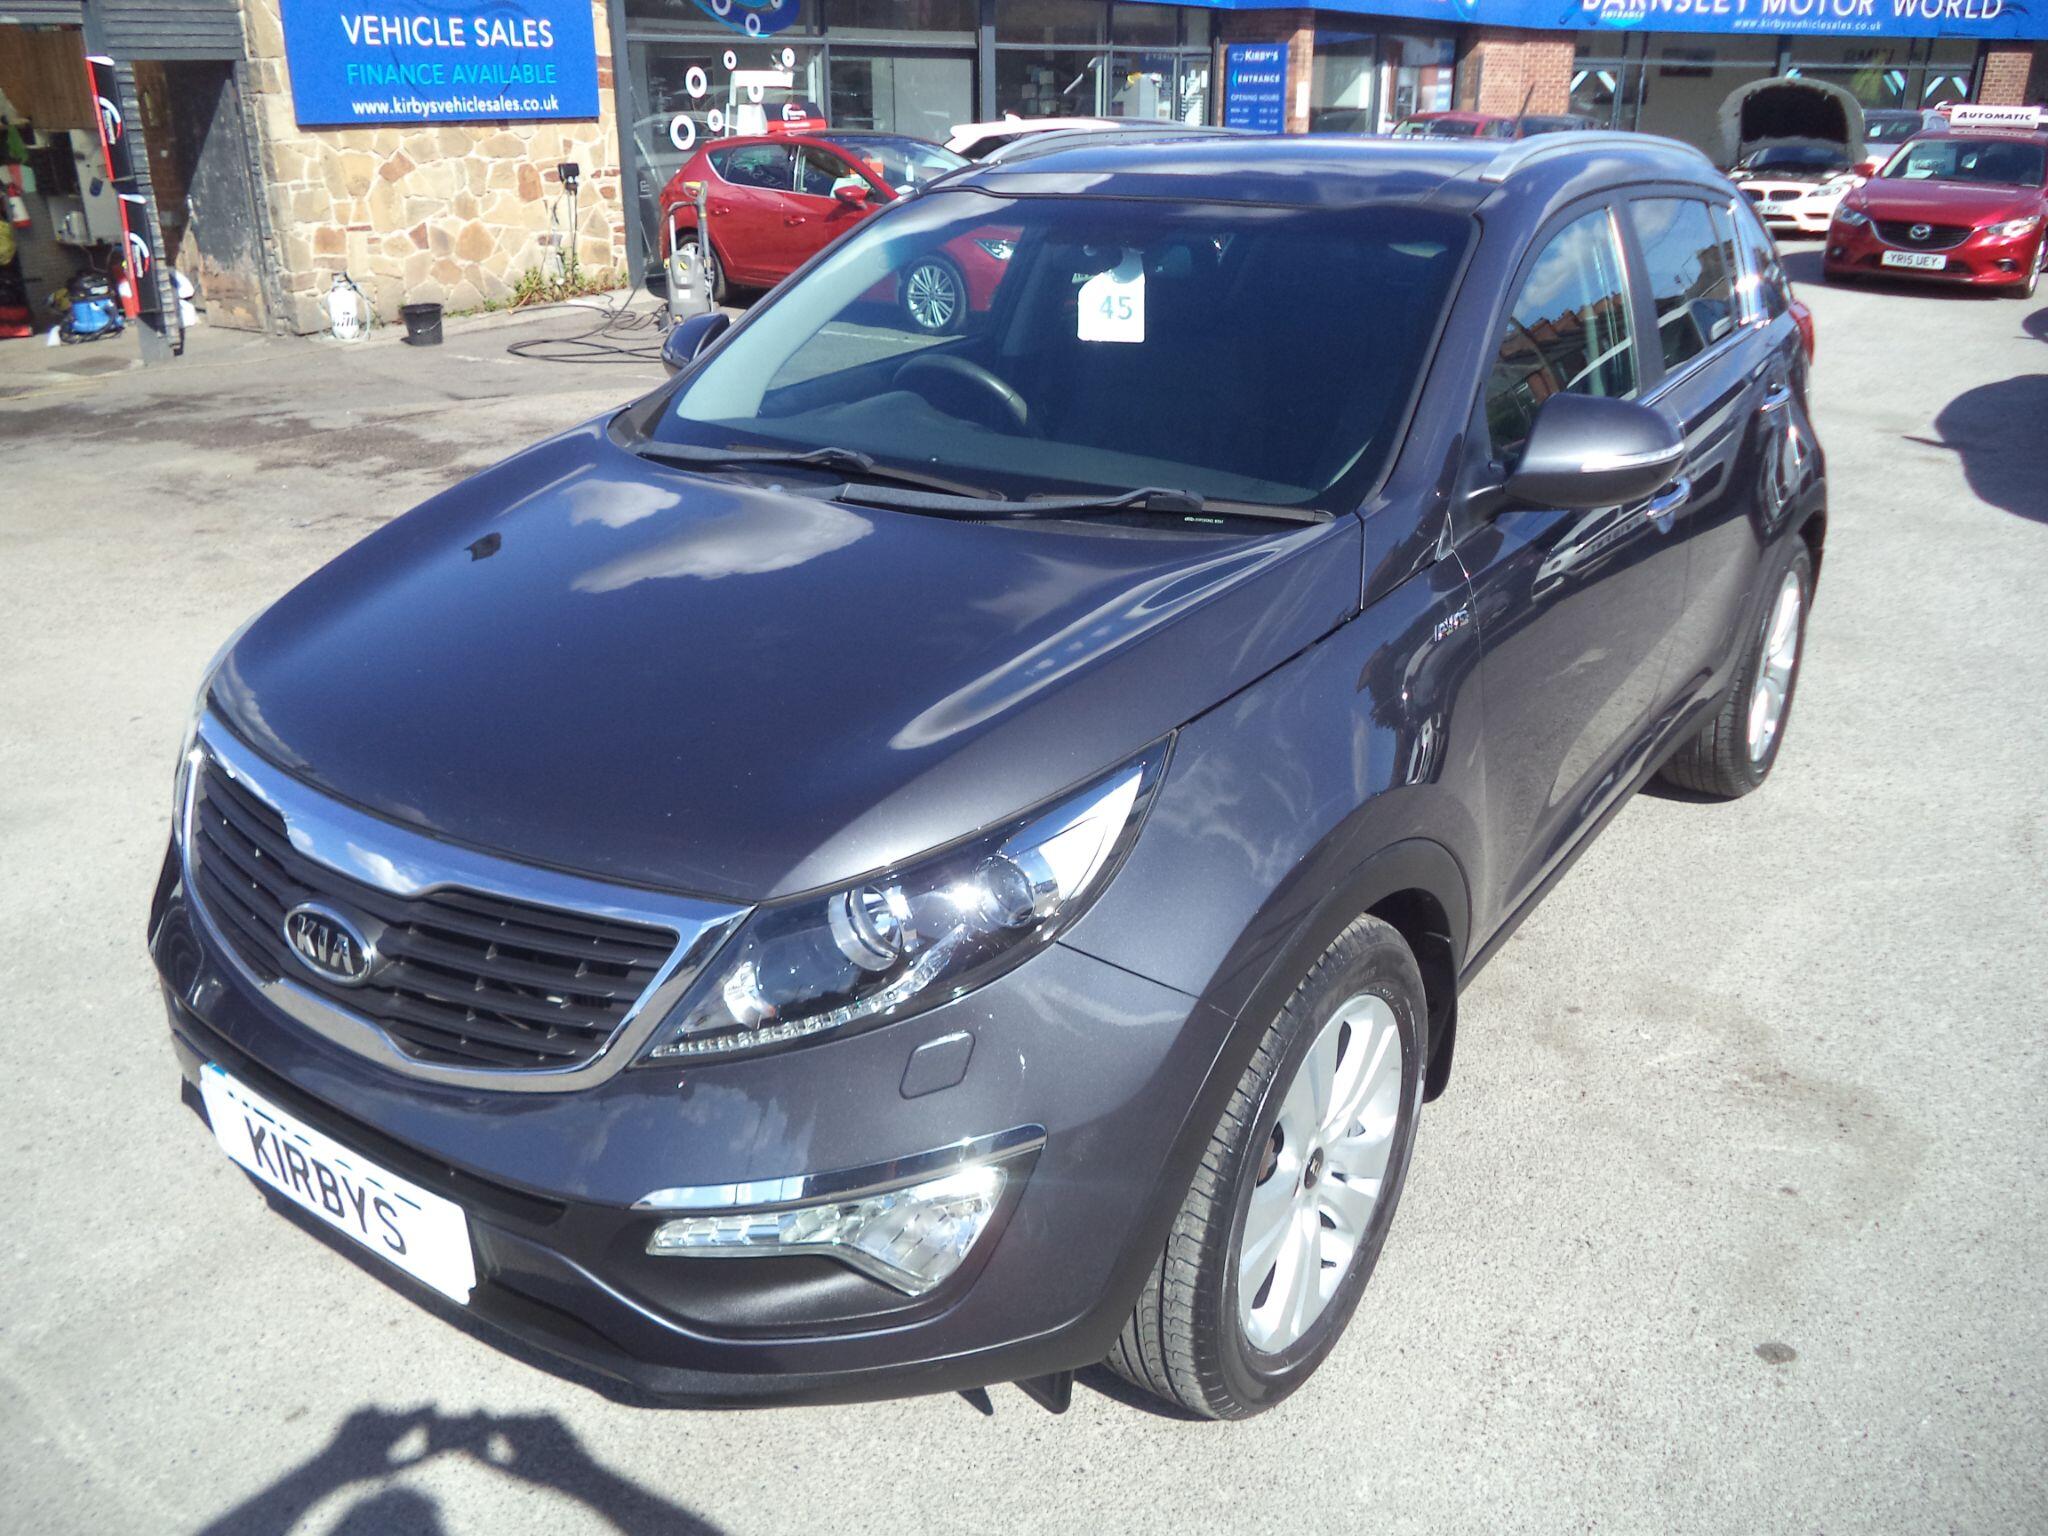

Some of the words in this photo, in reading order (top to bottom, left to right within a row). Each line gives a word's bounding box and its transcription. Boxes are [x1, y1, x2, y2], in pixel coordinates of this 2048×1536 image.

[1894, 0, 2002, 19] WORLD
[342, 15, 465, 46] VEHICLE
[474, 19, 554, 47] SALES
[1244, 50, 1279, 61] KIRBY'S
[347, 64, 445, 84] FINANCE
[452, 64, 556, 84] AVAILABLE
[1238, 74, 1280, 83] ENTRANCE
[352, 95, 559, 117] www.kirbysvehiclesales.co.uk
[1957, 111, 2032, 121] AUTOMATIC
[1890, 254, 1913, 265] YR15
[1100, 296, 1133, 320] 45
[297, 915, 355, 975] KIA
[244, 1116, 407, 1256] KIRBYS
